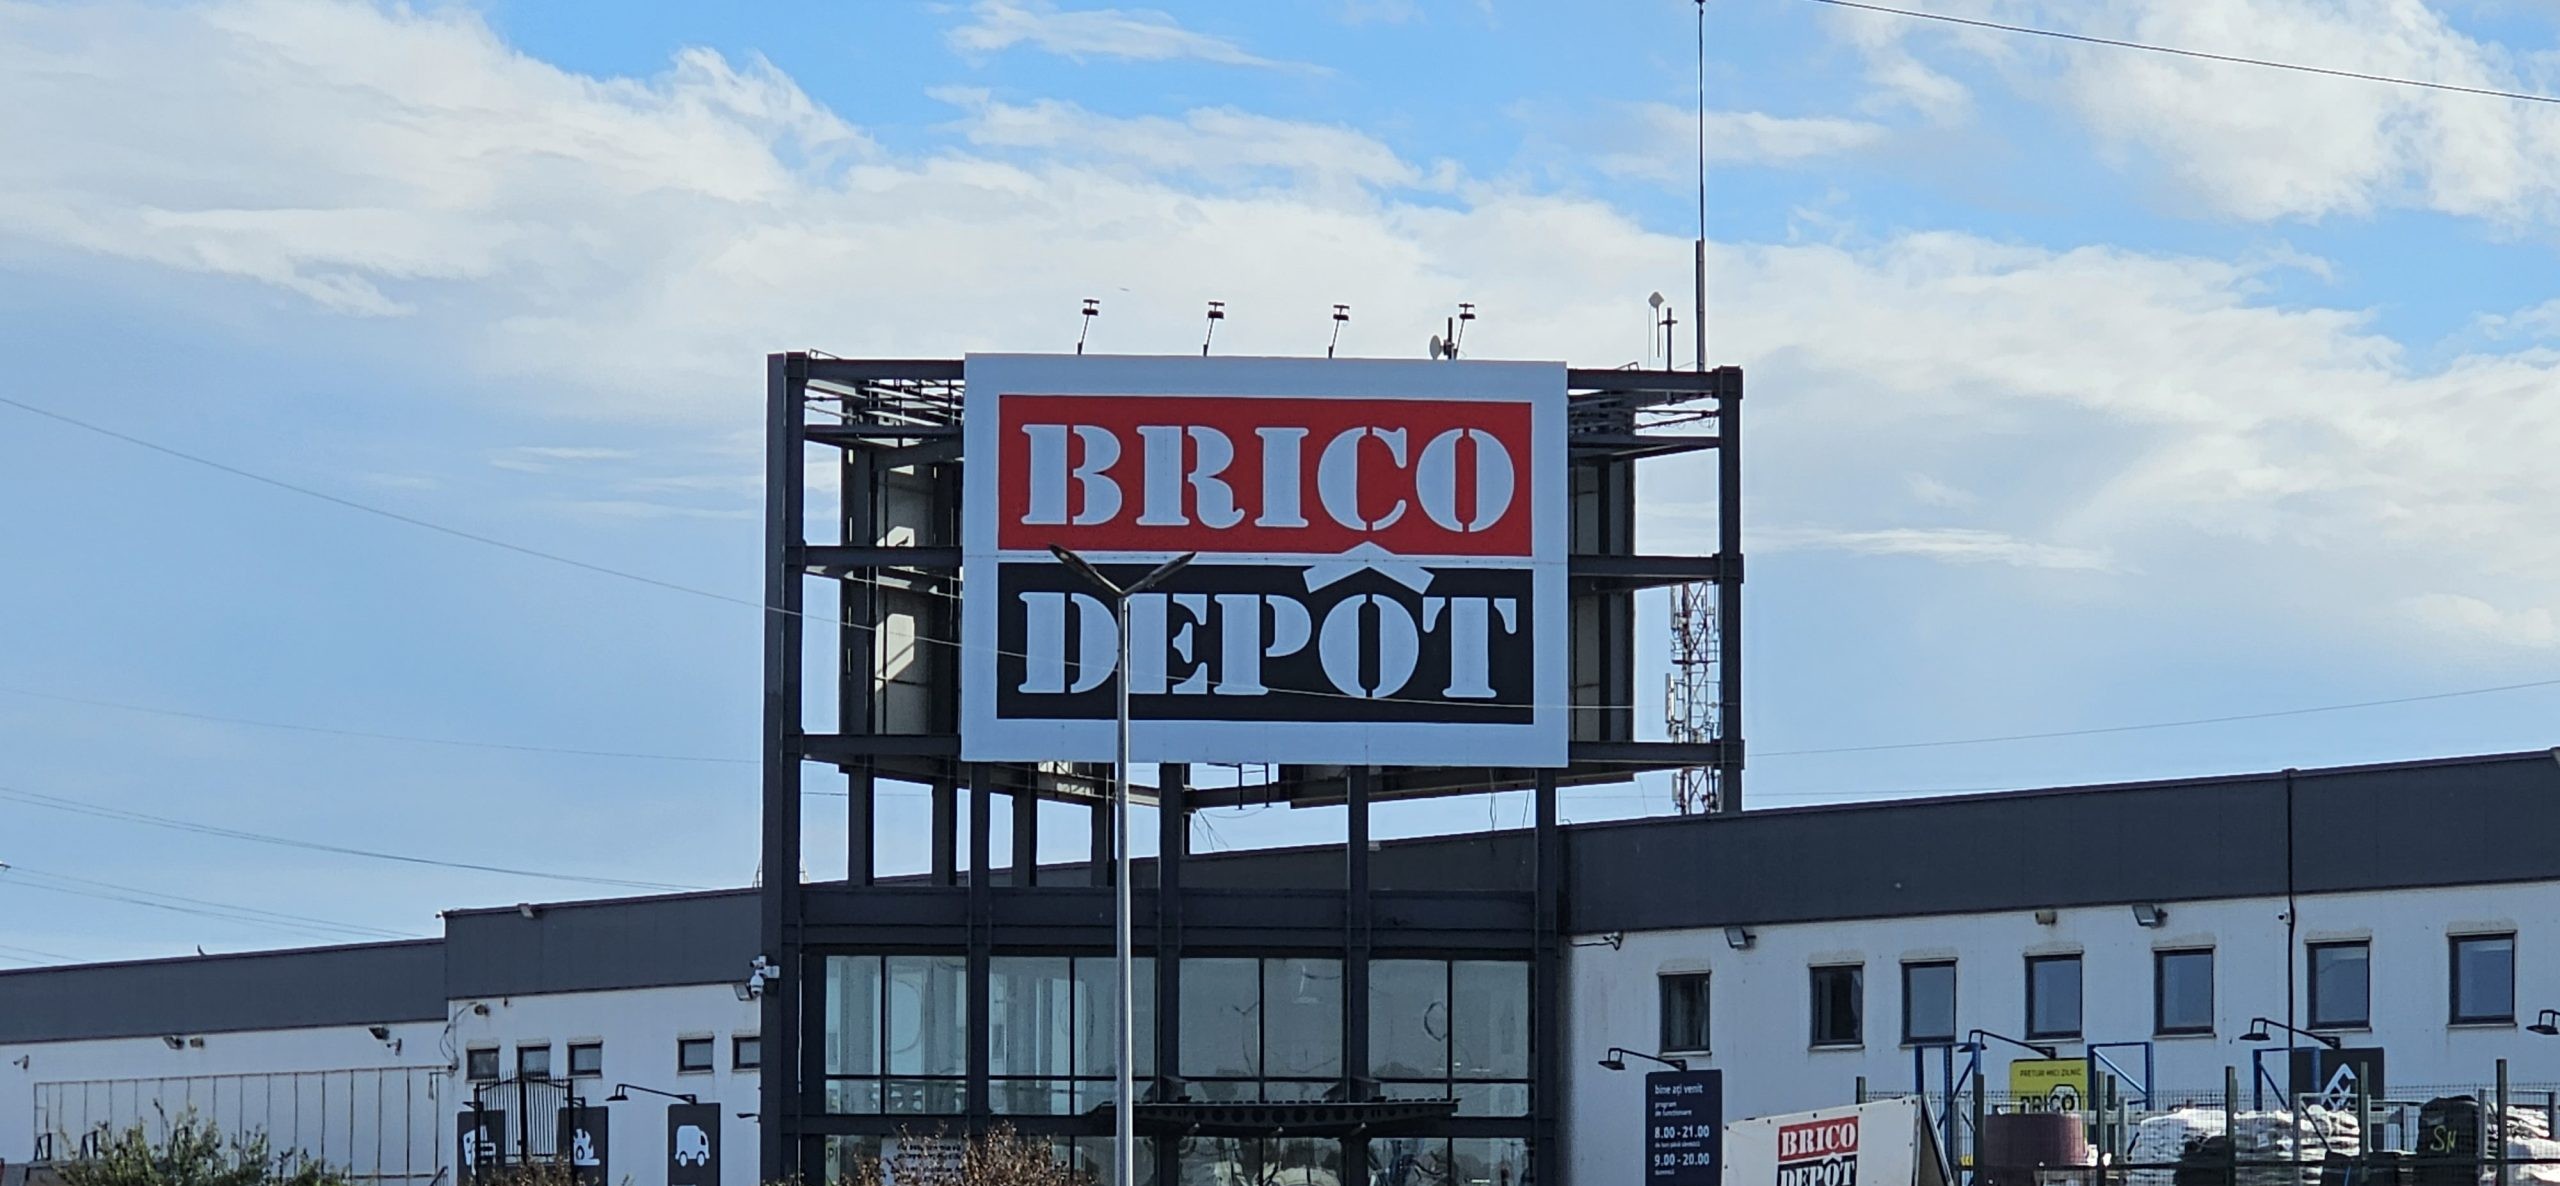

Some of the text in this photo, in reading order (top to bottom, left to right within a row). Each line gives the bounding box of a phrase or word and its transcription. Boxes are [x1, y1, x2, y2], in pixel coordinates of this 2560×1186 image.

[1021, 424, 1515, 532] BRICO
[1018, 541, 1517, 699] DEPÔT
[1655, 1084, 1671, 1094] bine
[1684, 1083, 1703, 1094] venit
[1654, 1126, 1675, 1139] 8.00
[1682, 1125, 1710, 1138] 21.00
[1781, 1123, 1856, 1156] BRICO
[1654, 1153, 1675, 1167] 9.00
[1682, 1152, 1710, 1166] 20.00
[1780, 1152, 1856, 1186] DEPÔT
